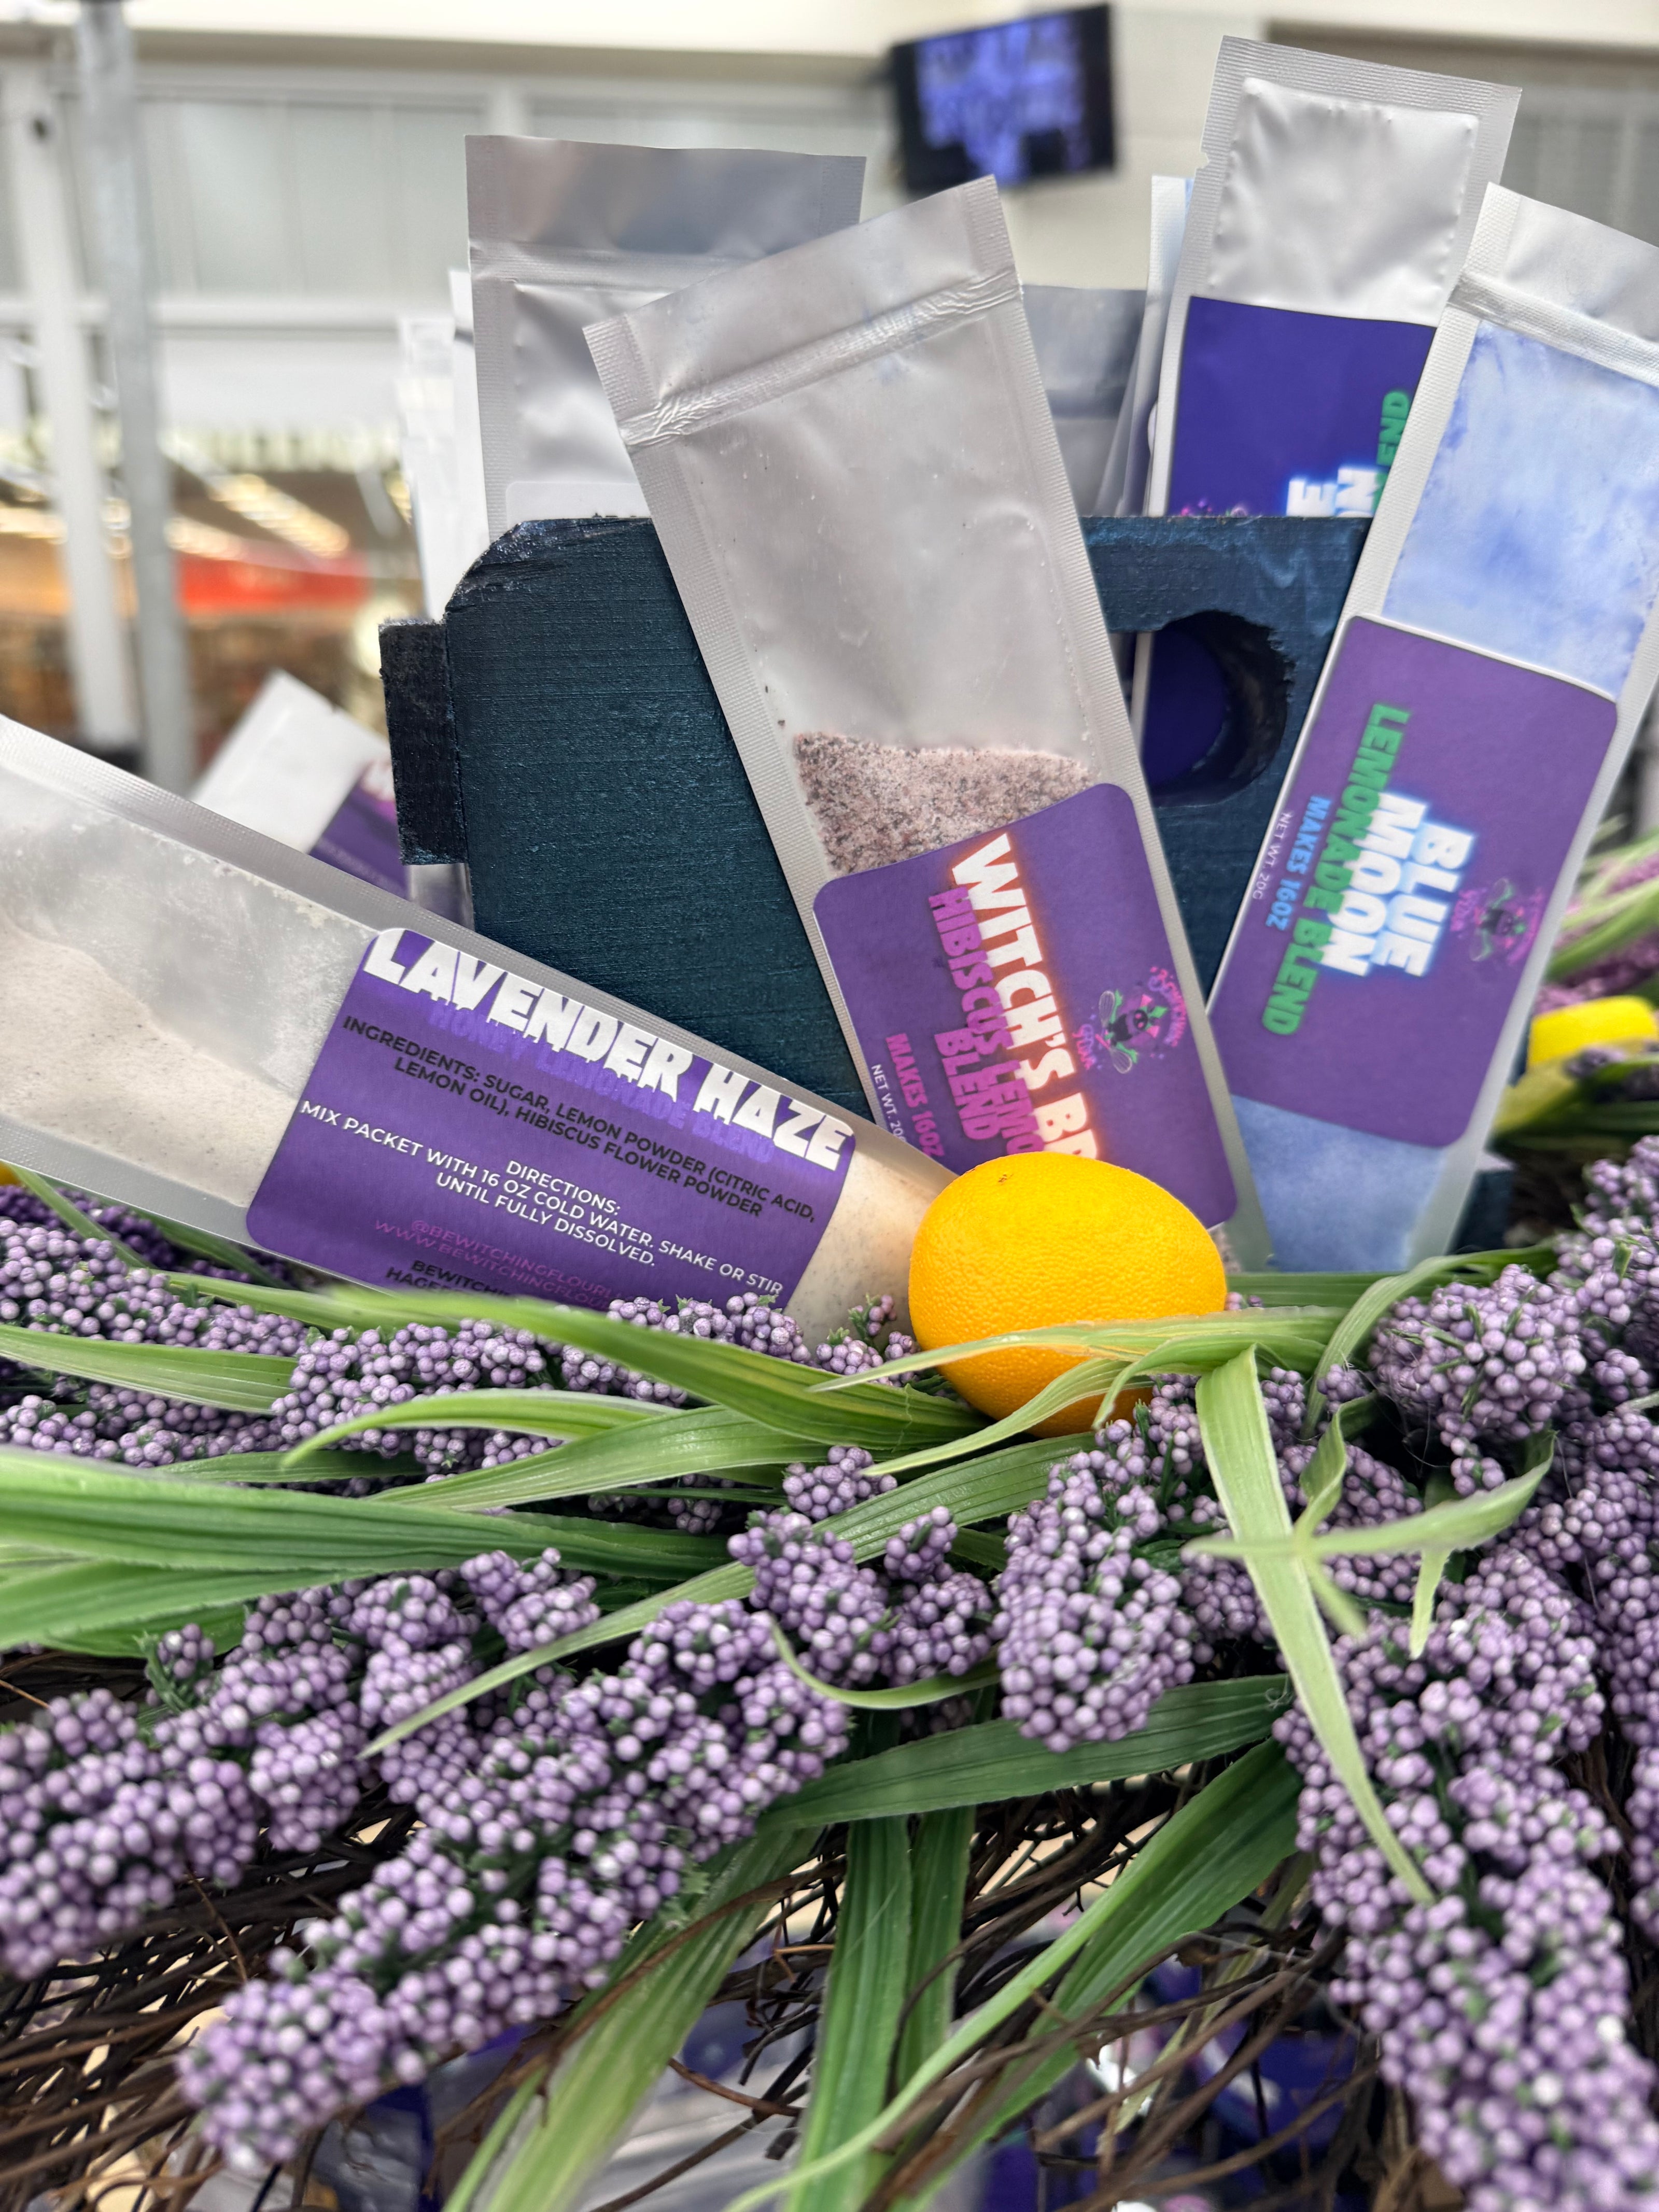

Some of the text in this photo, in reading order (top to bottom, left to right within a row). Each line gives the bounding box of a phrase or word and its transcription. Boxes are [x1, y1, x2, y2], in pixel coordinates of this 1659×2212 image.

[1261, 703, 1410, 1035] LEMONADE BLEND
[1274, 812, 1292, 839] NET
[1286, 795, 1331, 875] MAKES
[1321, 792, 1428, 977] MOON
[1370, 822, 1477, 977] BLUE
[928, 886, 1045, 1155] HIBISCUS LEMO
[952, 833, 1076, 1090] WITCH'S
[343, 1016, 815, 1223] INGREDIENTS: SUGAR, LEMON POWDER (CITRIC ACID,
[363, 929, 854, 1171] LAVENDER HAZE
[871, 1064, 889, 1090] NET
[881, 1093, 897, 1119] WT.
[885, 1034, 928, 1107] MAKES
[935, 1027, 1000, 1140] BLEND
[300, 1101, 784, 1295] MIX PACKET WITH 16 OZ COLD WATER. SHAKE OR STIR
[395, 1056, 466, 1095] LEMON
[515, 1107, 599, 1149] HIBISCUS
[603, 1143, 681, 1184] FLOWER
[684, 1175, 762, 1216] POWDER
[506, 1160, 621, 1216] DIRECTIONS:
[436, 1172, 655, 1266] UNTIL FULLY DISSOLVED.
